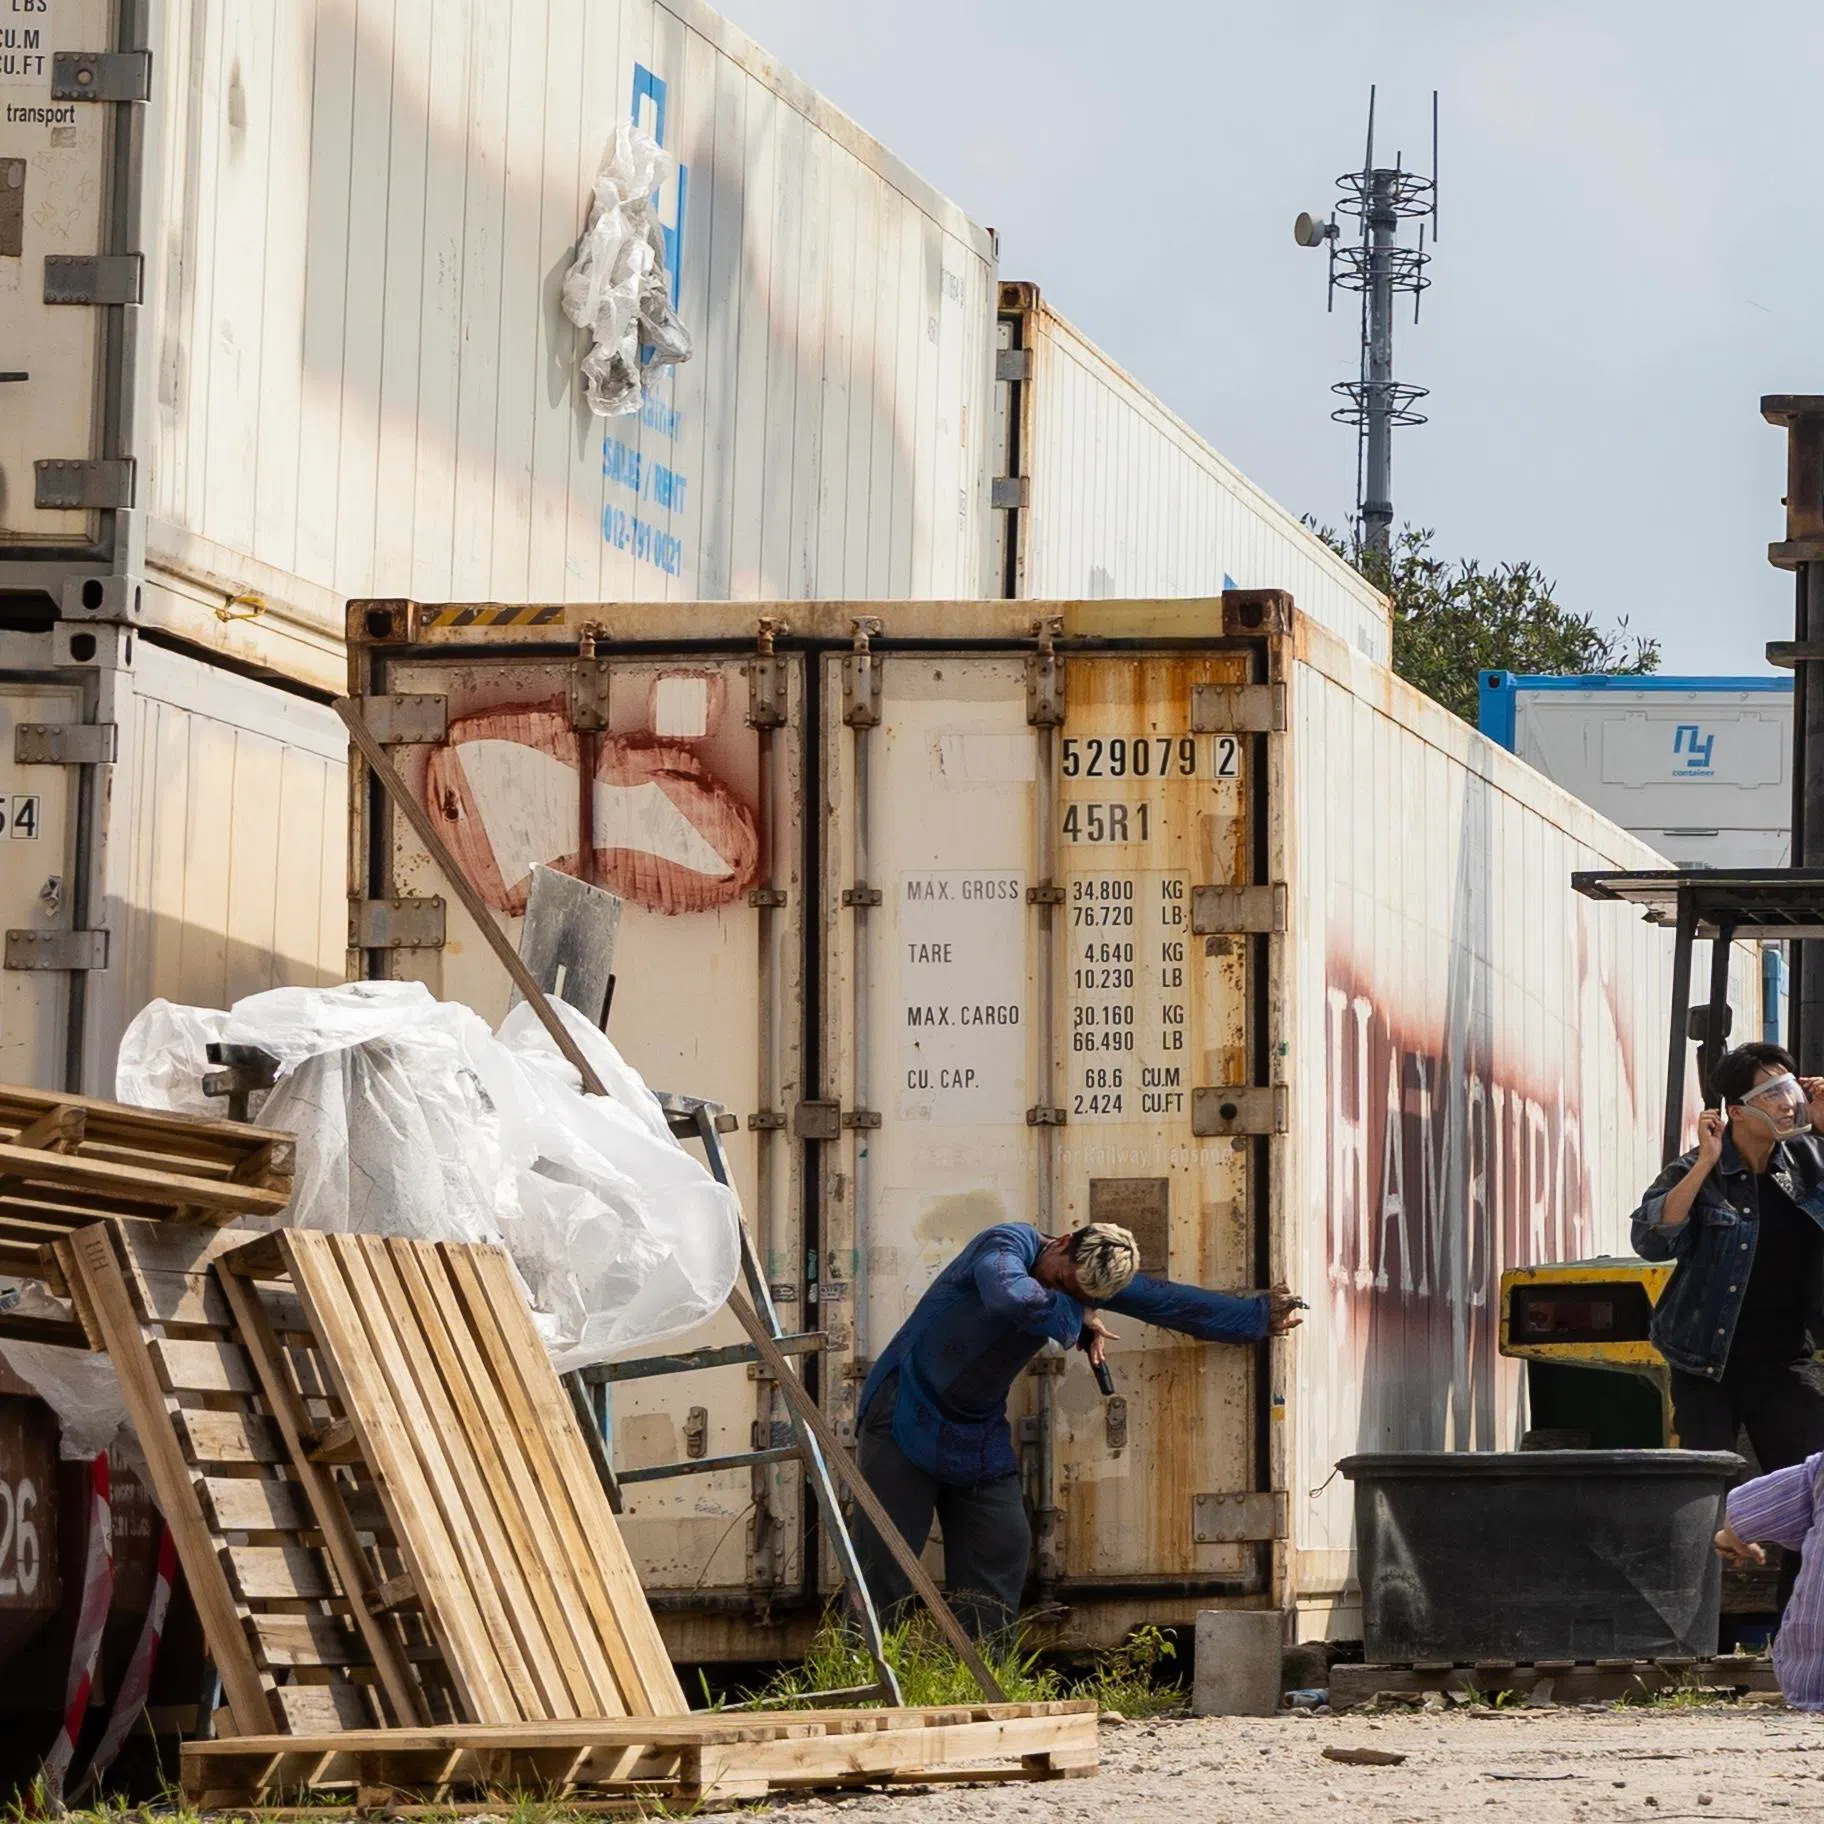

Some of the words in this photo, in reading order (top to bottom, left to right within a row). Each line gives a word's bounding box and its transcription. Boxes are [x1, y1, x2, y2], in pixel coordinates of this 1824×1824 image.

[0, 55, 46, 76] U.FT
[6, 103, 76, 127] transport
[1062, 738, 1196, 777] 529079
[1218, 738, 1236, 776] 2
[1062, 803, 1149, 843] 45R1
[907, 881, 955, 900] MAX.
[962, 880, 1019, 900] GROSS
[1073, 880, 1134, 900] 34.800
[1162, 880, 1184, 899] KG
[1073, 906, 1134, 927] 76.720
[1162, 906, 1183, 925] LB
[908, 943, 953, 963] TARE
[1085, 943, 1134, 963] 4.640
[1162, 943, 1184, 962] KG
[1075, 969, 1134, 988] 10.230
[1162, 968, 1183, 988] LB
[907, 1006, 956, 1026] MAX.
[961, 1005, 1020, 1026] CARGO
[1073, 1005, 1134, 1026] 30.160
[1163, 1005, 1184, 1024] KG
[1073, 1031, 1134, 1052] 66.490
[1163, 1031, 1183, 1051] LB
[907, 1069, 934, 1089] CU.
[940, 1069, 979, 1088] CAP.
[1085, 1068, 1123, 1089] 68.6
[1142, 1067, 1180, 1088] CU.M
[1074, 1095, 1123, 1115] 2.424
[1142, 1094, 1184, 1114] CU.FT
